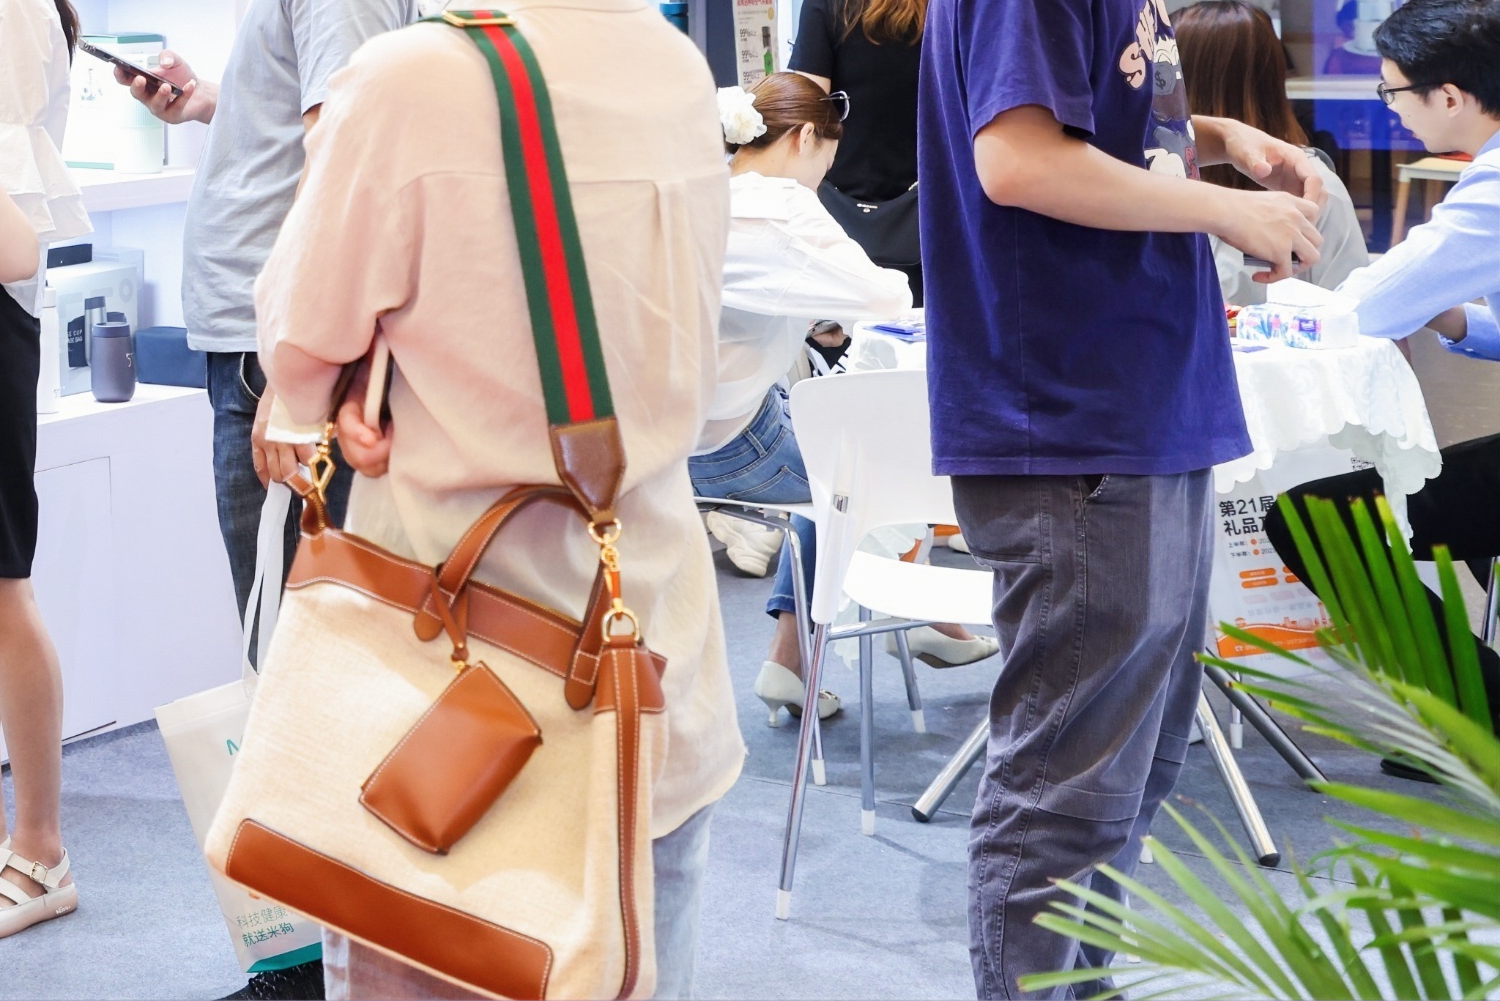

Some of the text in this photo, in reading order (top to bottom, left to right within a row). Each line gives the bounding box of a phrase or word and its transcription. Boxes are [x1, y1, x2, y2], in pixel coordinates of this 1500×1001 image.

[236, 896, 294, 930] 科技健康
[242, 922, 295, 947] 就送米狗
